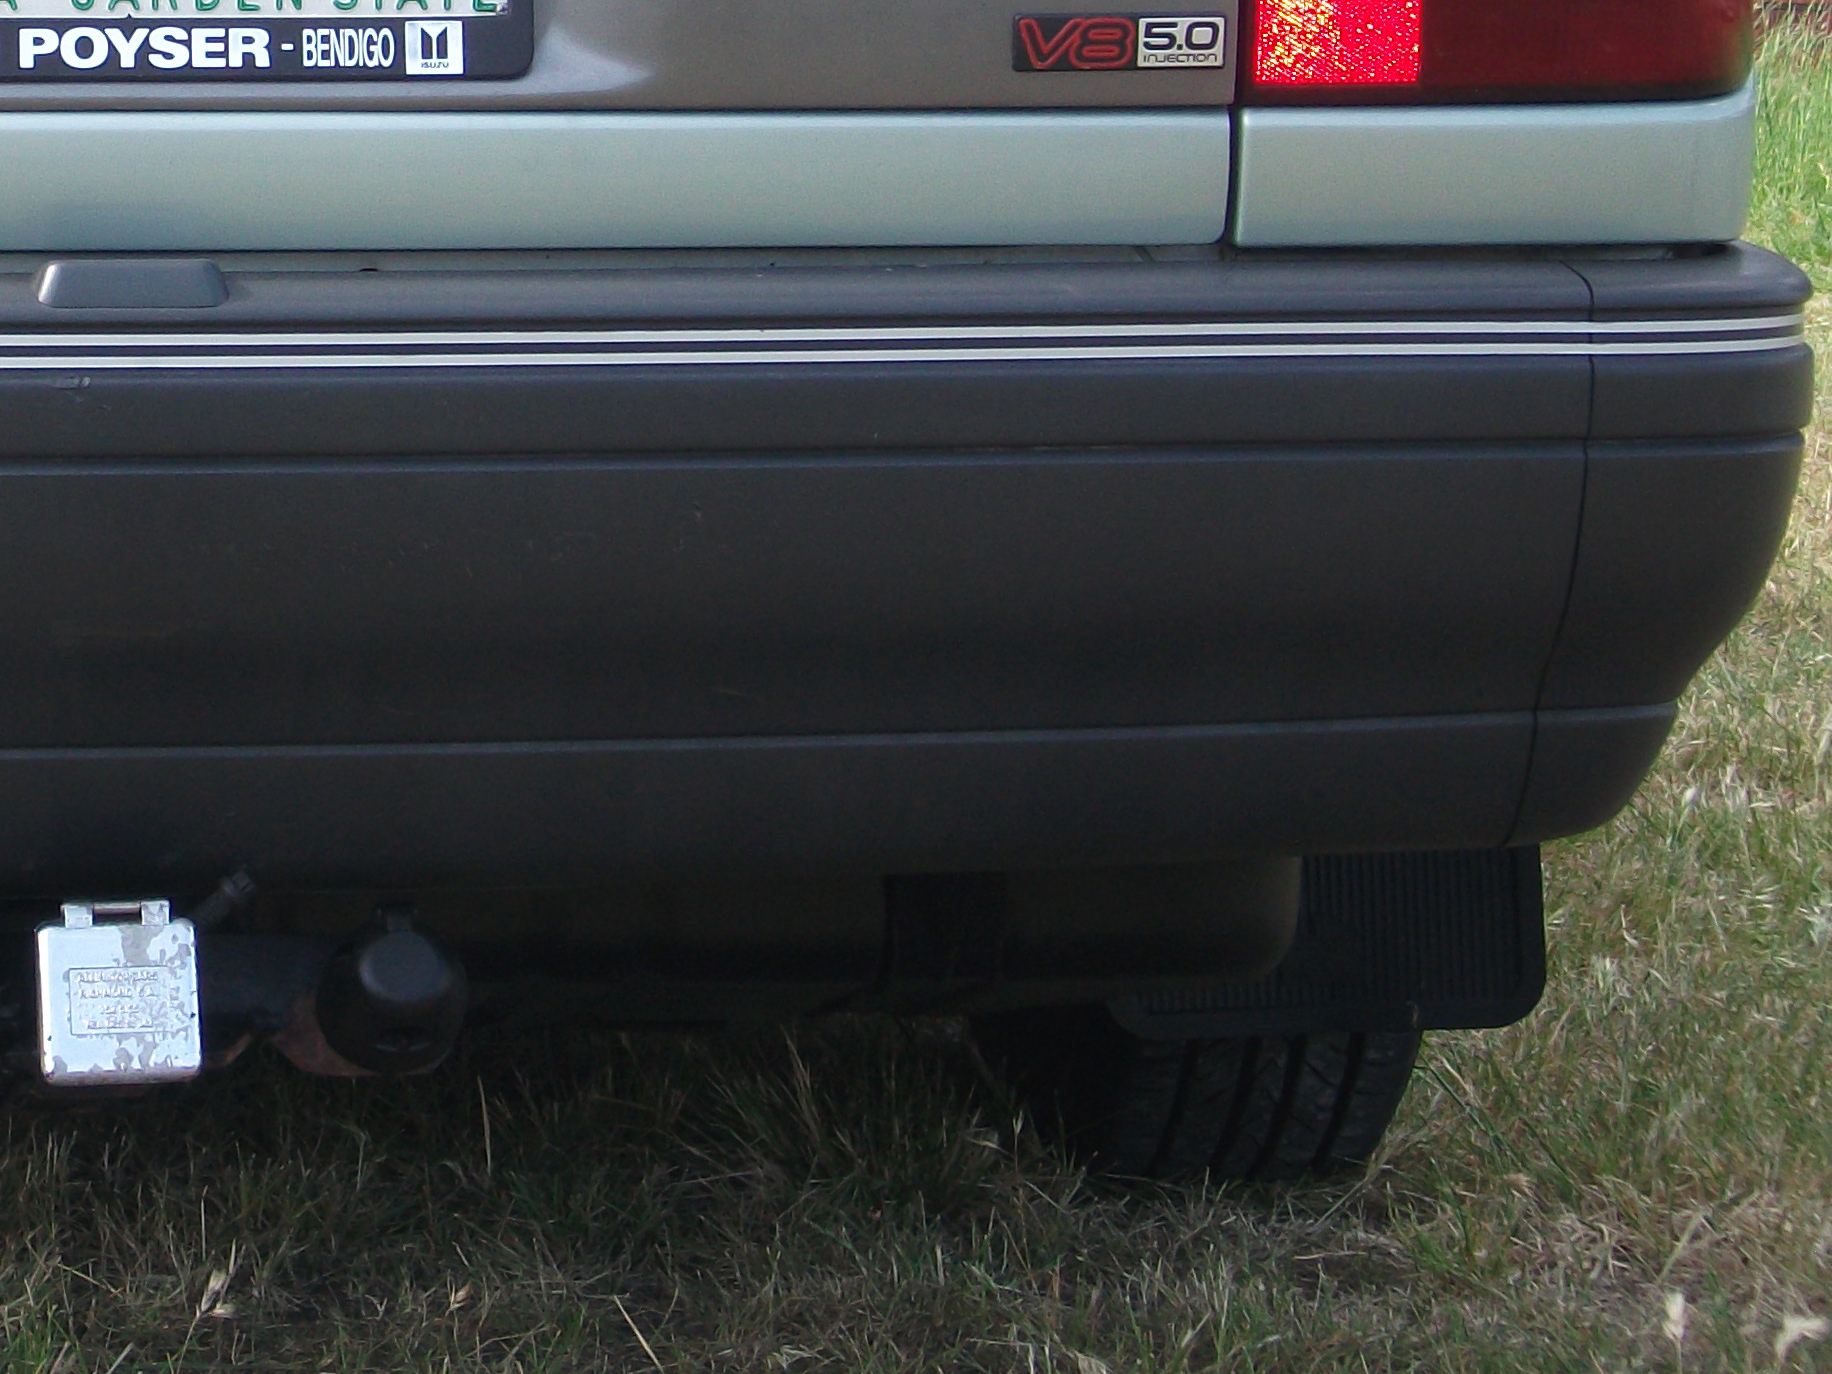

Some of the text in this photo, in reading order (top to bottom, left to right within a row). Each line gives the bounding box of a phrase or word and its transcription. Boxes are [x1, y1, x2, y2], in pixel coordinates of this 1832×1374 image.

[18, 27, 271, 70] POYSER
[302, 28, 396, 69] BENDIGO
[1018, 17, 1137, 70] V8
[1142, 21, 1220, 51] 5.0
[1143, 53, 1218, 63] INJECTION
